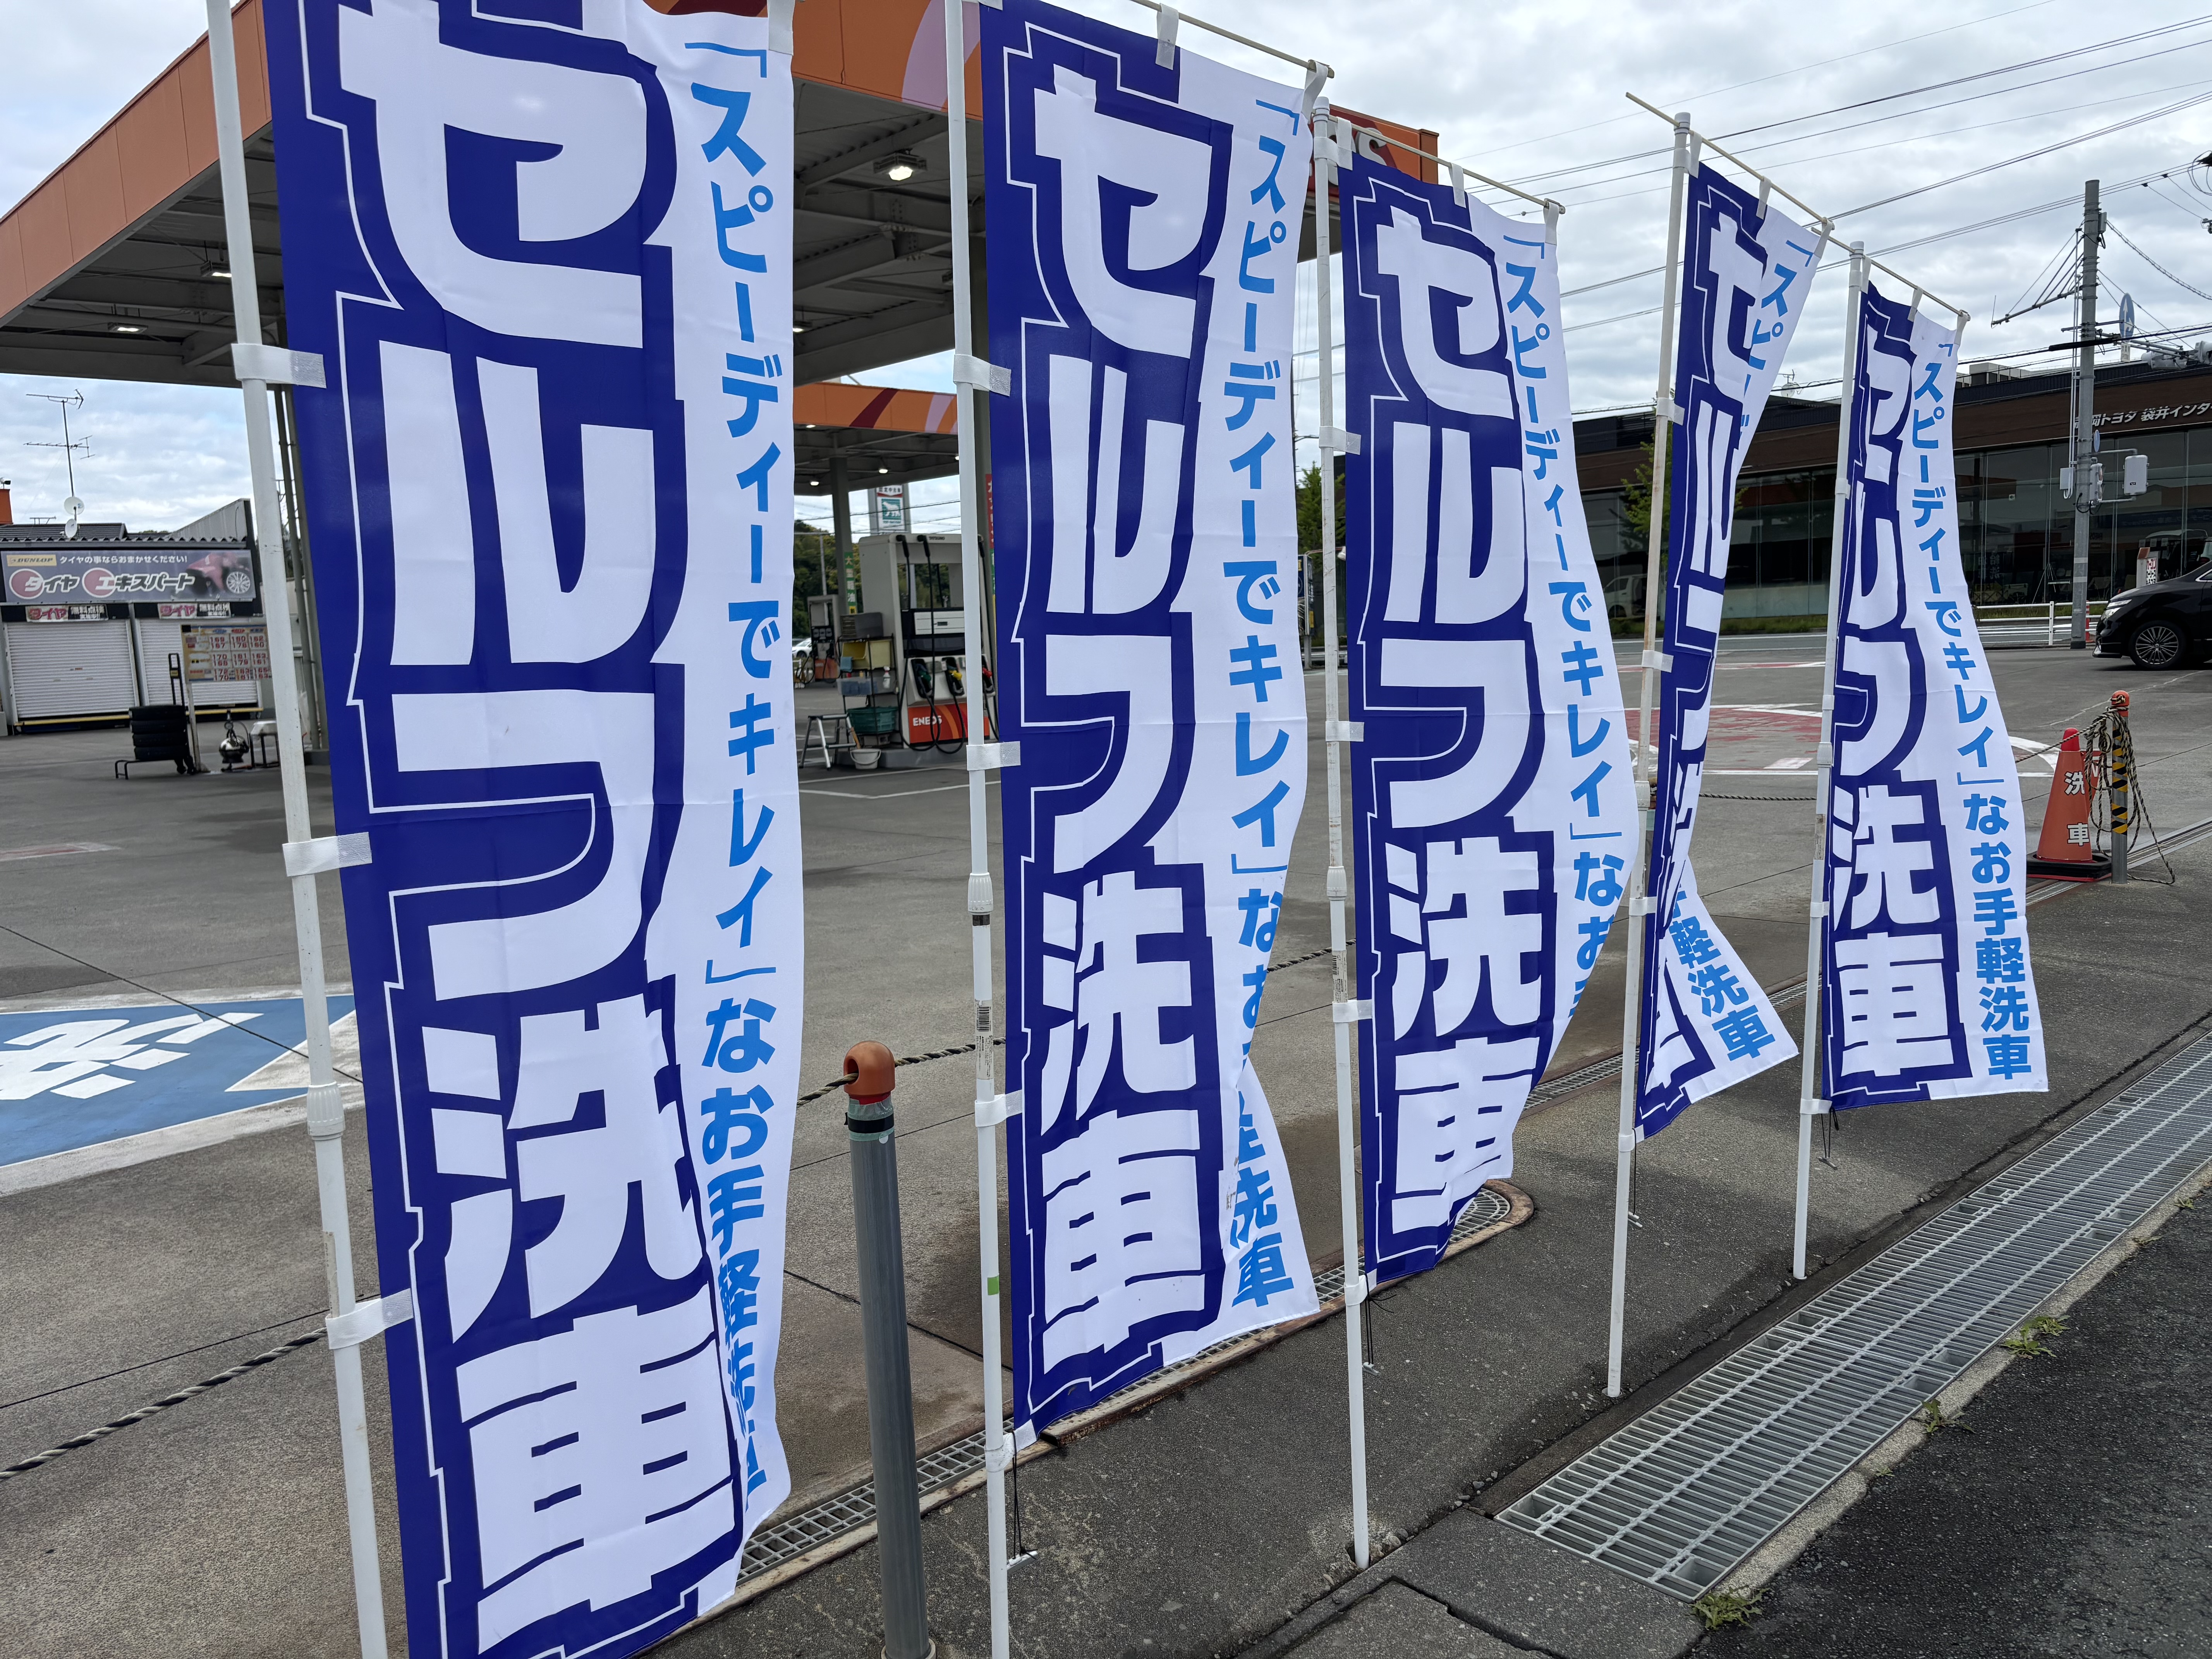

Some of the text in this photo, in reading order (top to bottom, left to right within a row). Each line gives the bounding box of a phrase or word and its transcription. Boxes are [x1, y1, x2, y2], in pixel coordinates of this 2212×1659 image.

[2141, 403, 2212, 421] 袋井インタ
[94, 572, 195, 593] エキスパート
[29, 608, 67, 620] タイヤ
[160, 605, 196, 617] タイヤ
[1034, 64, 1213, 1375] セルフ洗車
[1377, 205, 1542, 1234] セルフ洗車
[1911, 343, 2032, 1079] 「スピーディーでキレイ」なお手軽洗車
[2064, 771, 2089, 846] 洗車
